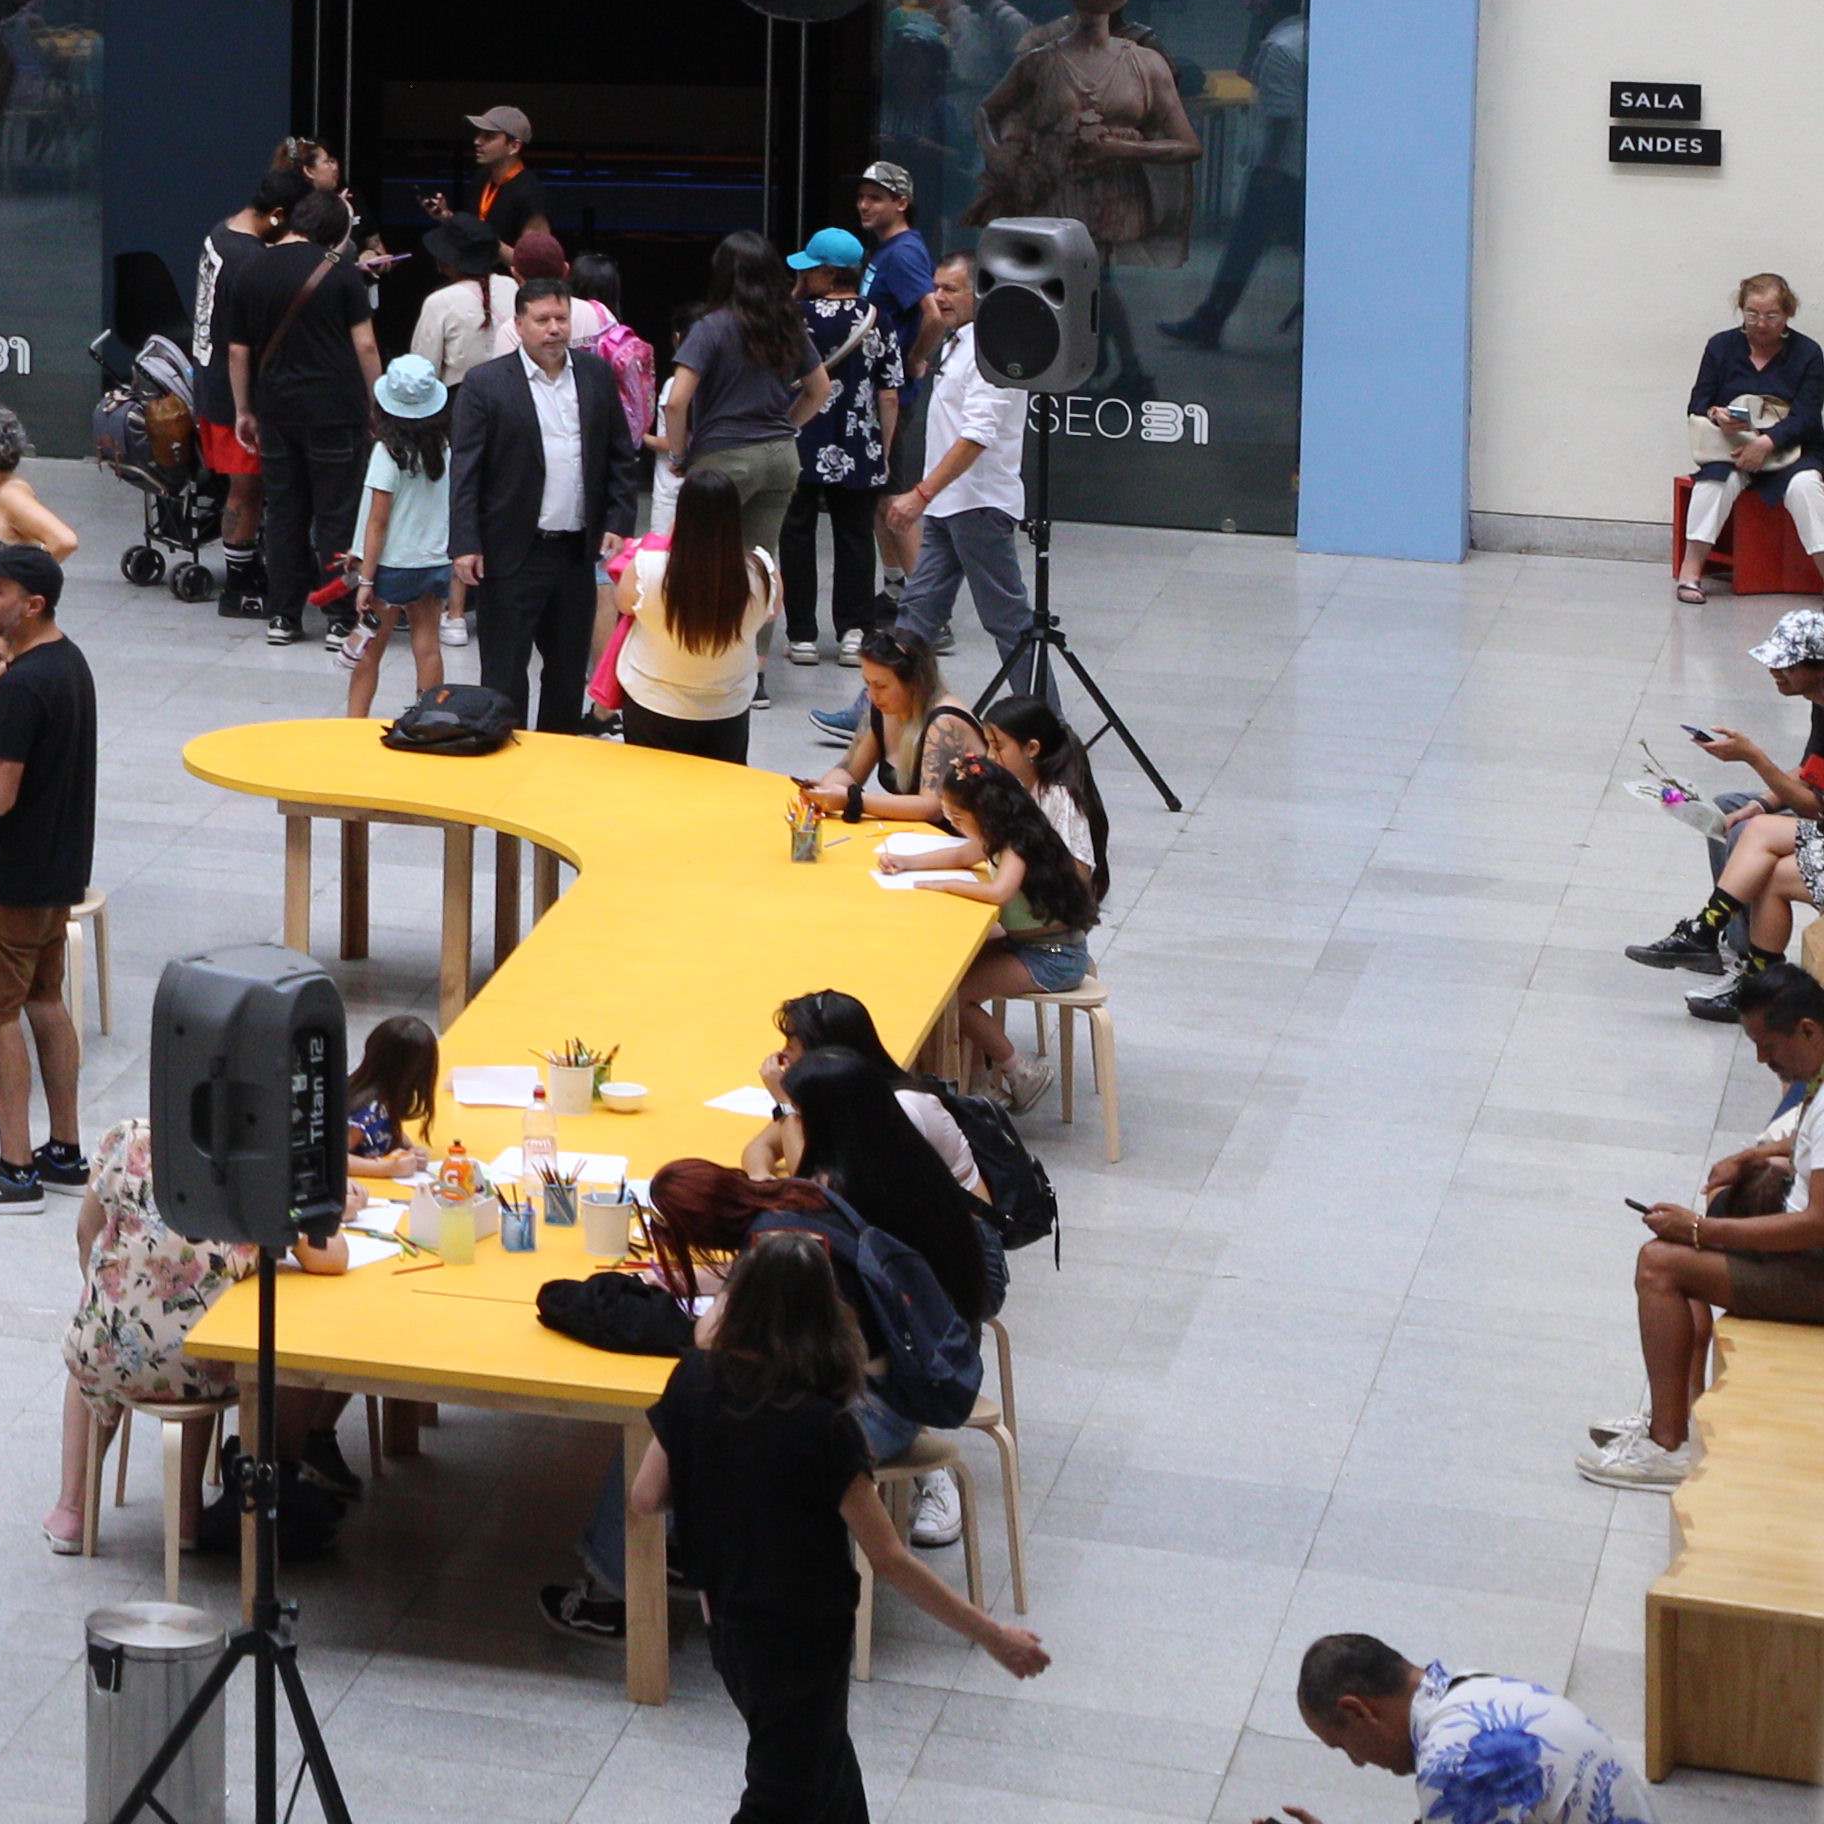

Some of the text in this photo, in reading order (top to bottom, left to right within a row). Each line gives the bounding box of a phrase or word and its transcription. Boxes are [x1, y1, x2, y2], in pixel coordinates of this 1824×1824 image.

[1620, 92, 1684, 109] SALA
[1619, 136, 1703, 154] ANDES
[1028, 394, 1133, 439] SEO
[309, 1036, 324, 1145] Titan 12
